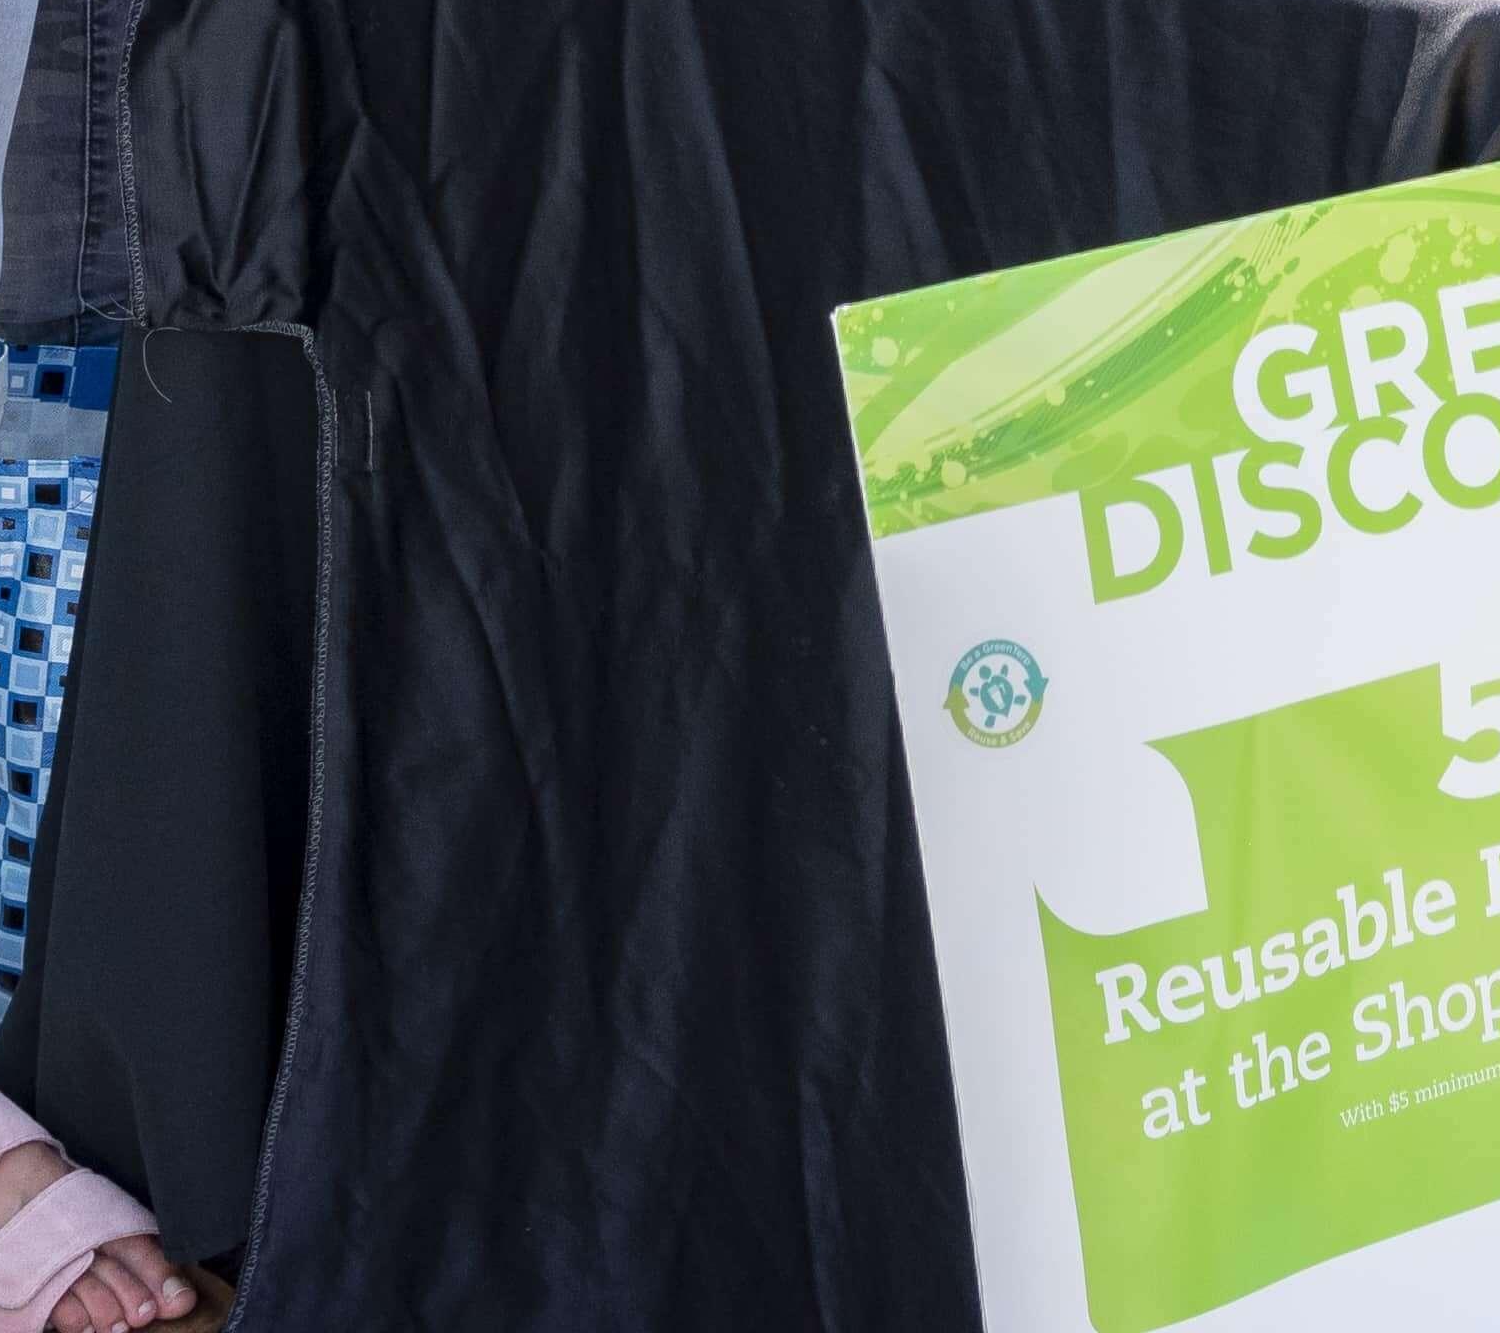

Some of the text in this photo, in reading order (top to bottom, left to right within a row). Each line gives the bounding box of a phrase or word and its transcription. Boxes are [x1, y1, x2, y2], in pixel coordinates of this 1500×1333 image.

[1096, 866, 1456, 1045] Reusable
[1141, 1067, 1211, 1140] at
[1228, 1030, 1331, 1112] the
[1339, 1098, 1384, 1129] With
[1388, 1091, 1410, 1116] $5
